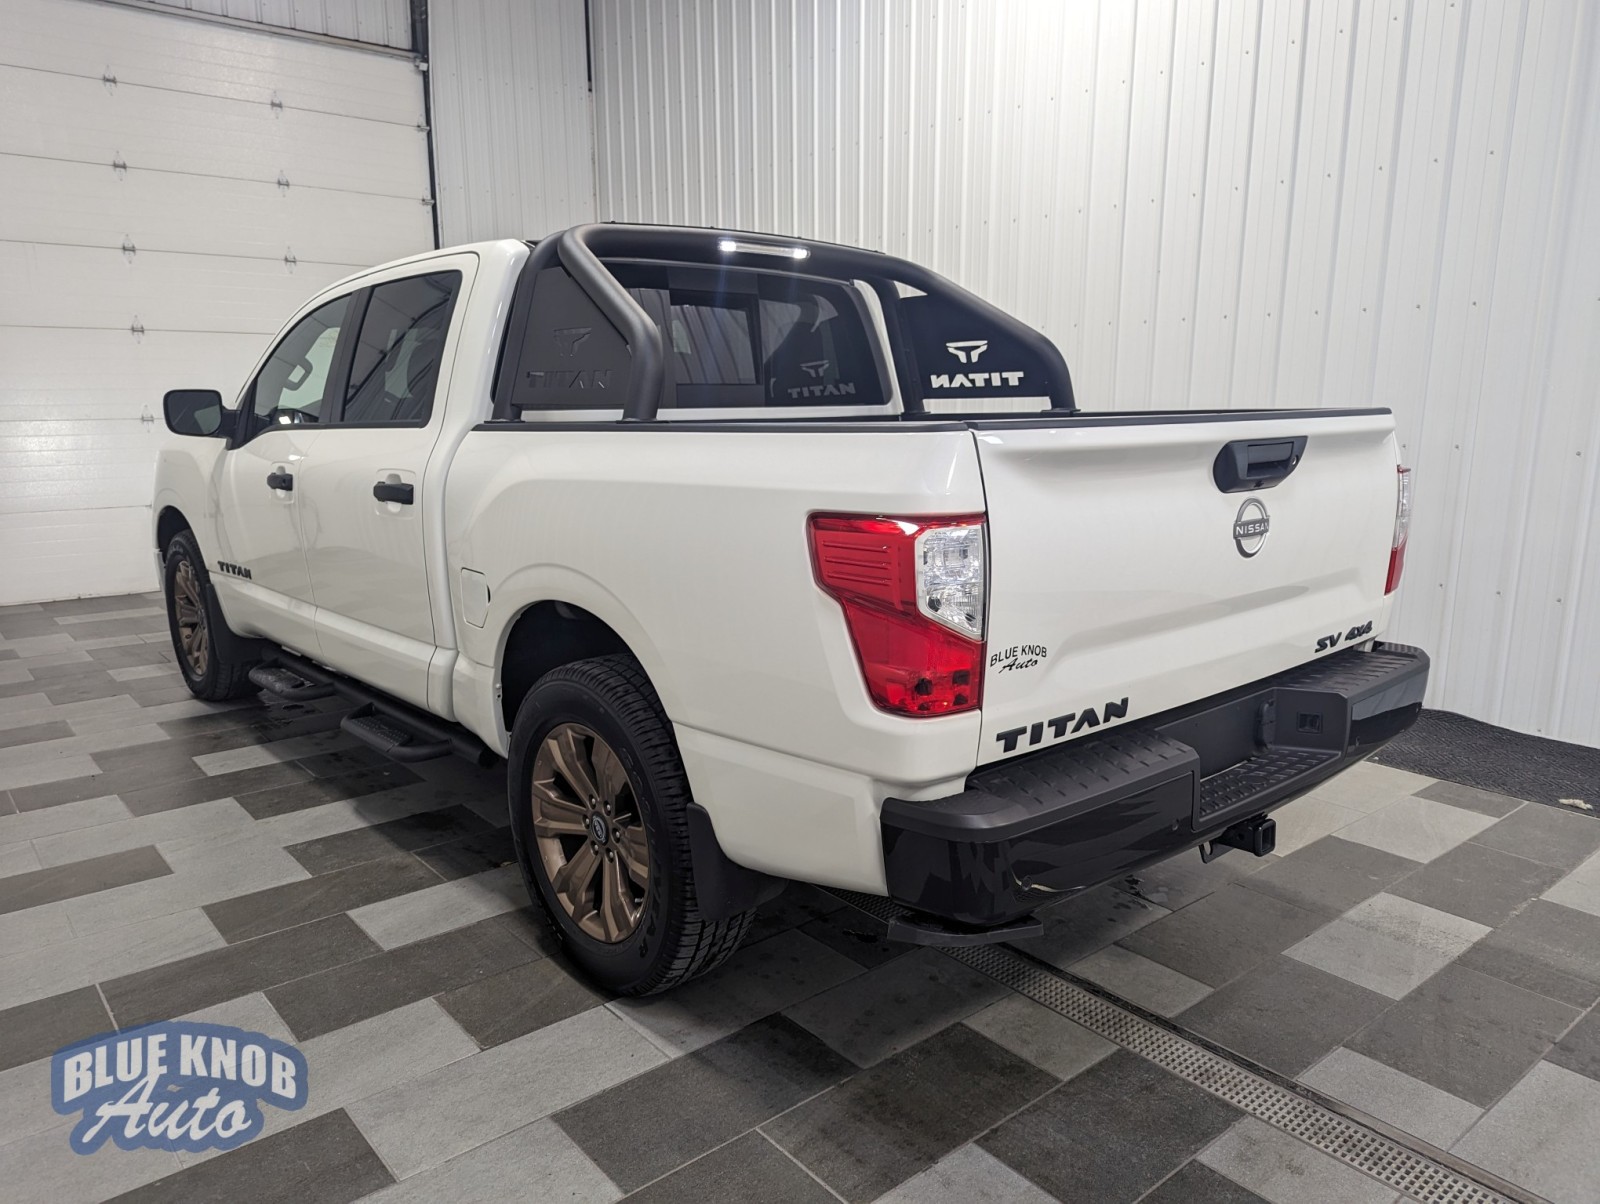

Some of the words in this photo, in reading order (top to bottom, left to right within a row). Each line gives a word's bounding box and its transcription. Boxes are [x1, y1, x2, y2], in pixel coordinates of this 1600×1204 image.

[526, 369, 616, 389] TITAN
[787, 382, 856, 399] TITAN
[1235, 521, 1269, 536] NISSAN
[217, 560, 252, 580] TITAN
[1314, 631, 1342, 653] SV
[990, 646, 1019, 667] BLUE
[1021, 645, 1047, 658] KNOB
[998, 657, 1038, 673] Auto
[996, 697, 1129, 753] TITAN
